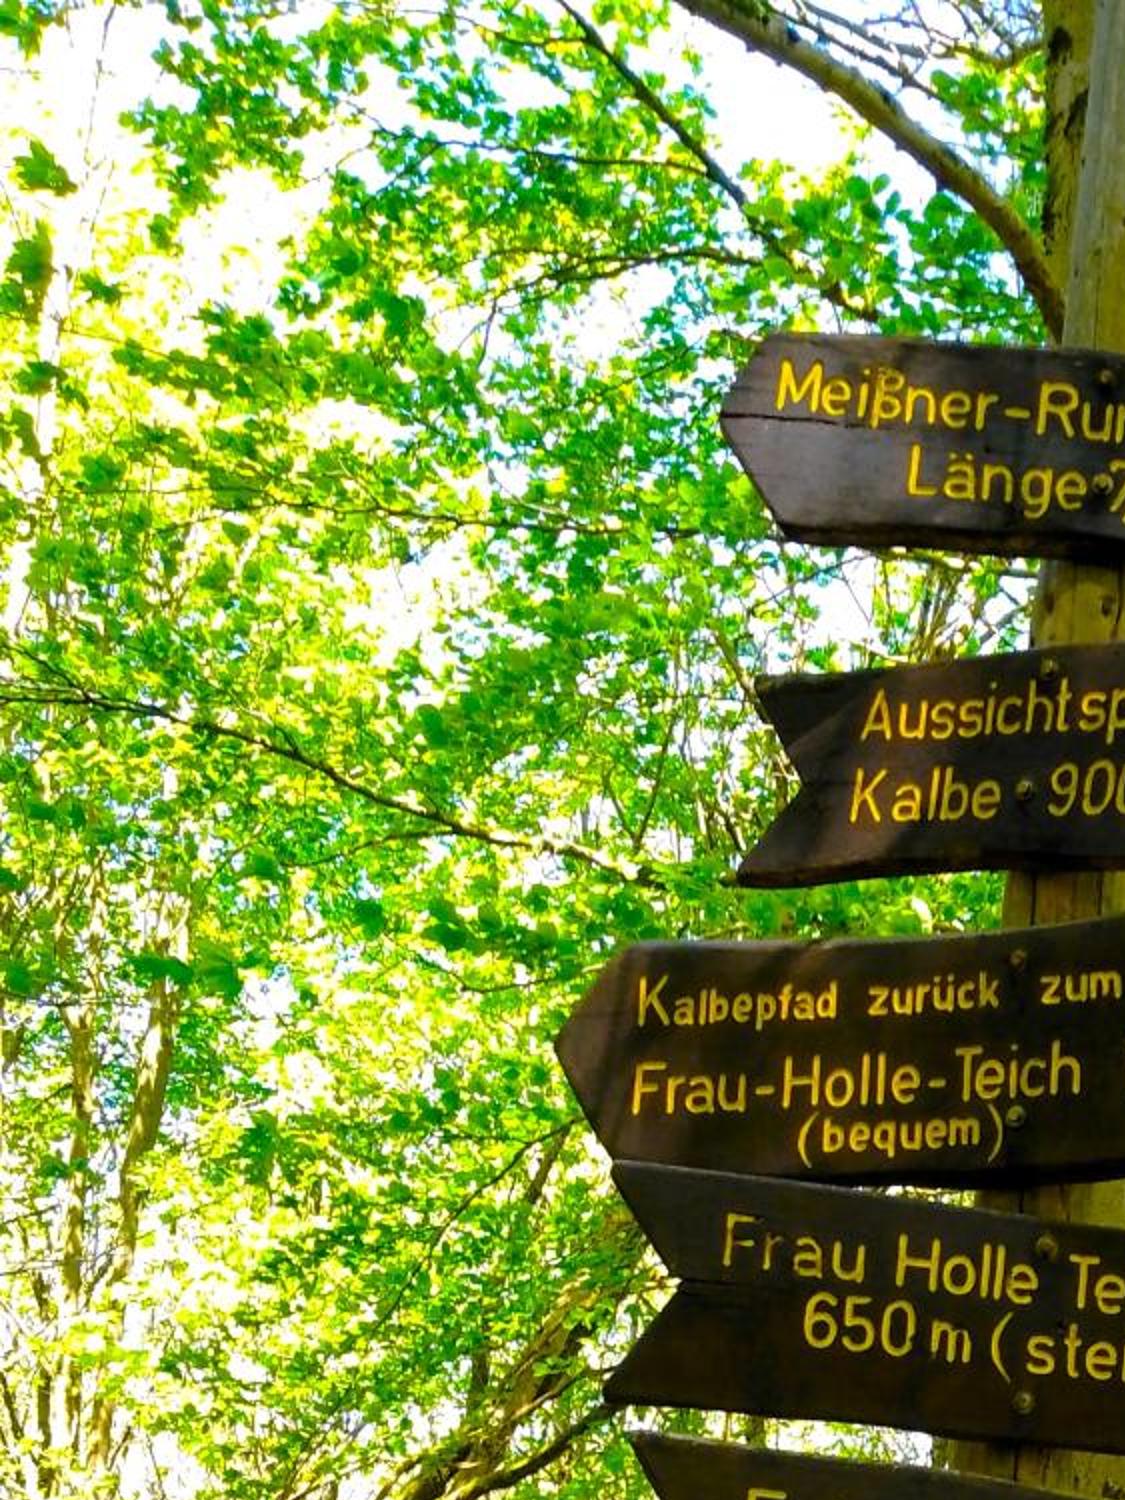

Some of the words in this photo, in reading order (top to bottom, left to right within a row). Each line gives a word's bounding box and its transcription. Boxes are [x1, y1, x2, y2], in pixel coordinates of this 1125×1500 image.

[905, 444, 1089, 519] Länge
[848, 768, 1002, 823] Kalbe
[636, 973, 838, 1030] Kalbepfad
[868, 971, 1000, 1015] zurück
[1040, 969, 1122, 1004] zum
[630, 1039, 1082, 1116] Frau-Holle-Teich
[797, 1104, 1005, 1166] (bequem)
[721, 1213, 867, 1284] Frau
[894, 1233, 1039, 1305] Holle
[802, 1292, 917, 1356] 650
[931, 1319, 972, 1363] m
